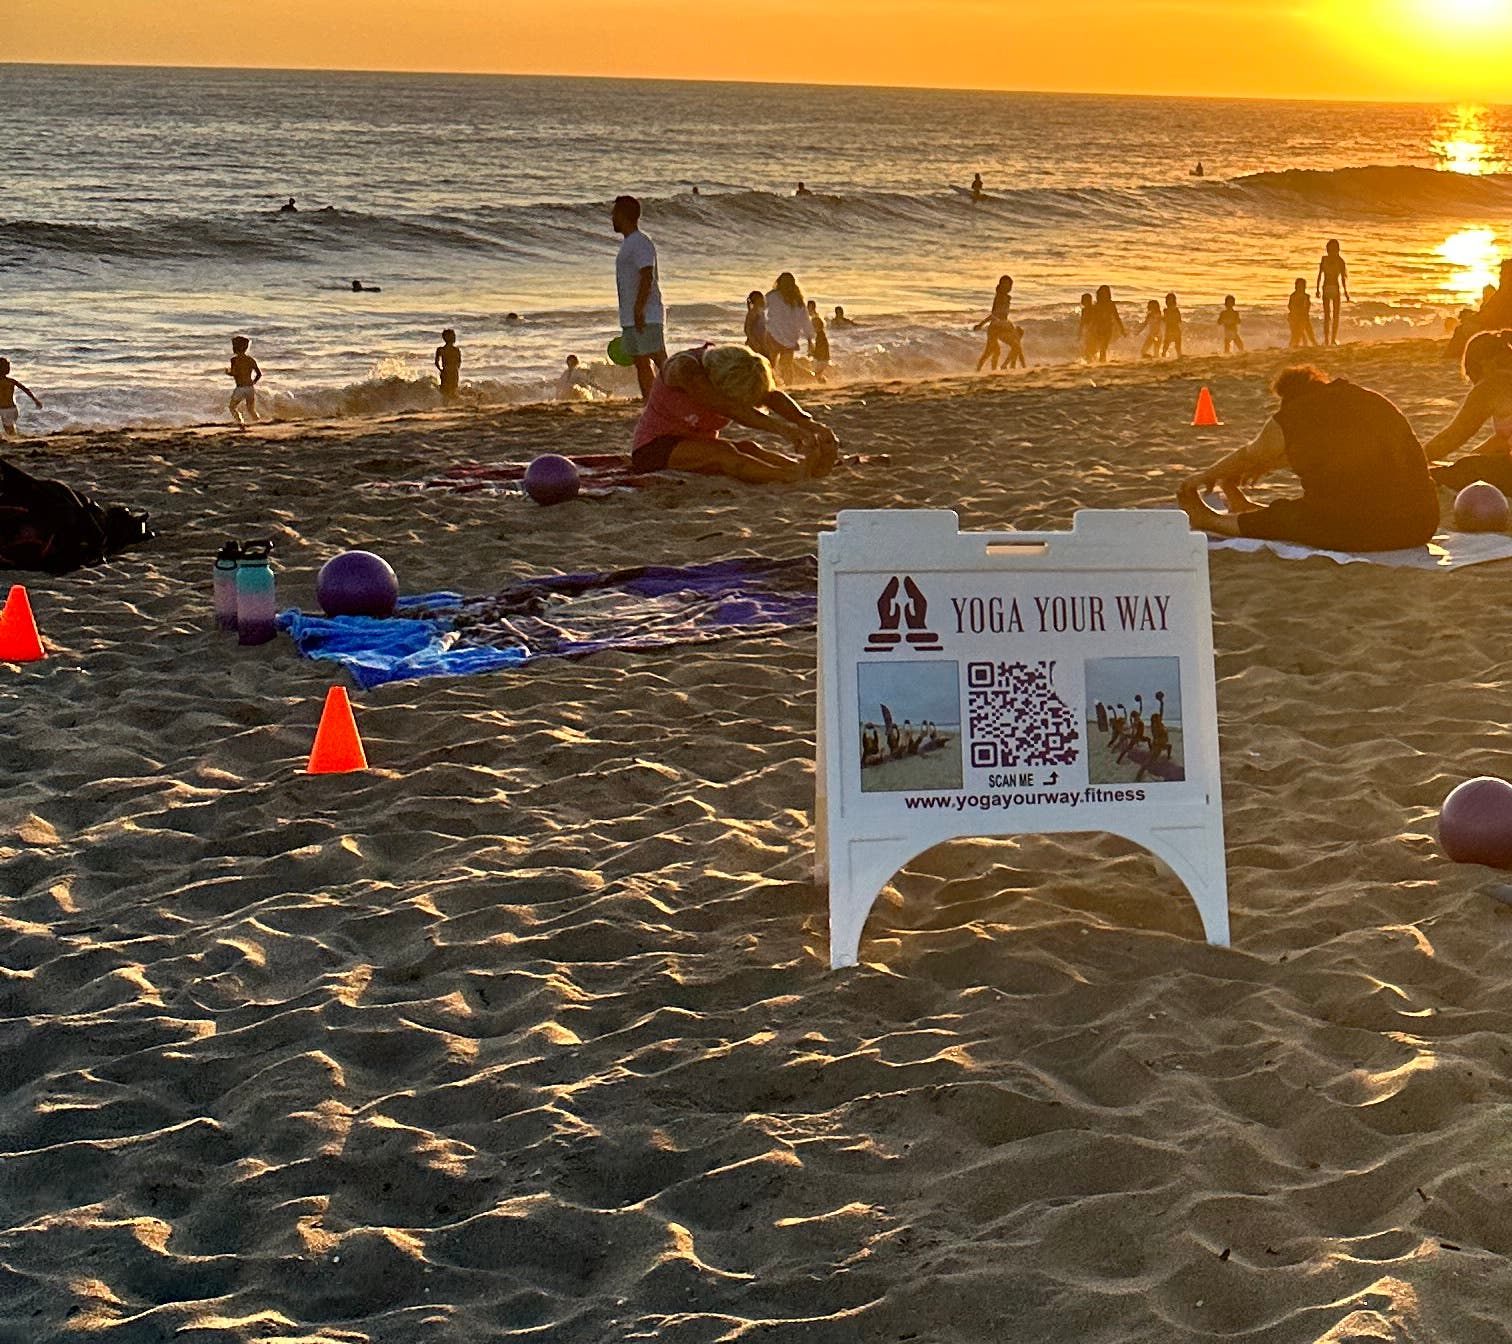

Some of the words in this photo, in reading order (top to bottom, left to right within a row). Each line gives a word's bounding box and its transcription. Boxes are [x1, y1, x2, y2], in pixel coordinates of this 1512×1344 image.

[951, 597, 1024, 634] YOGA
[1034, 596, 1106, 632] YOUR
[1115, 595, 1170, 631] WAY
[988, 774, 1016, 788] SCAN
[1019, 773, 1034, 787] ME
[904, 787, 1146, 811] www.yogayourway.fitness
